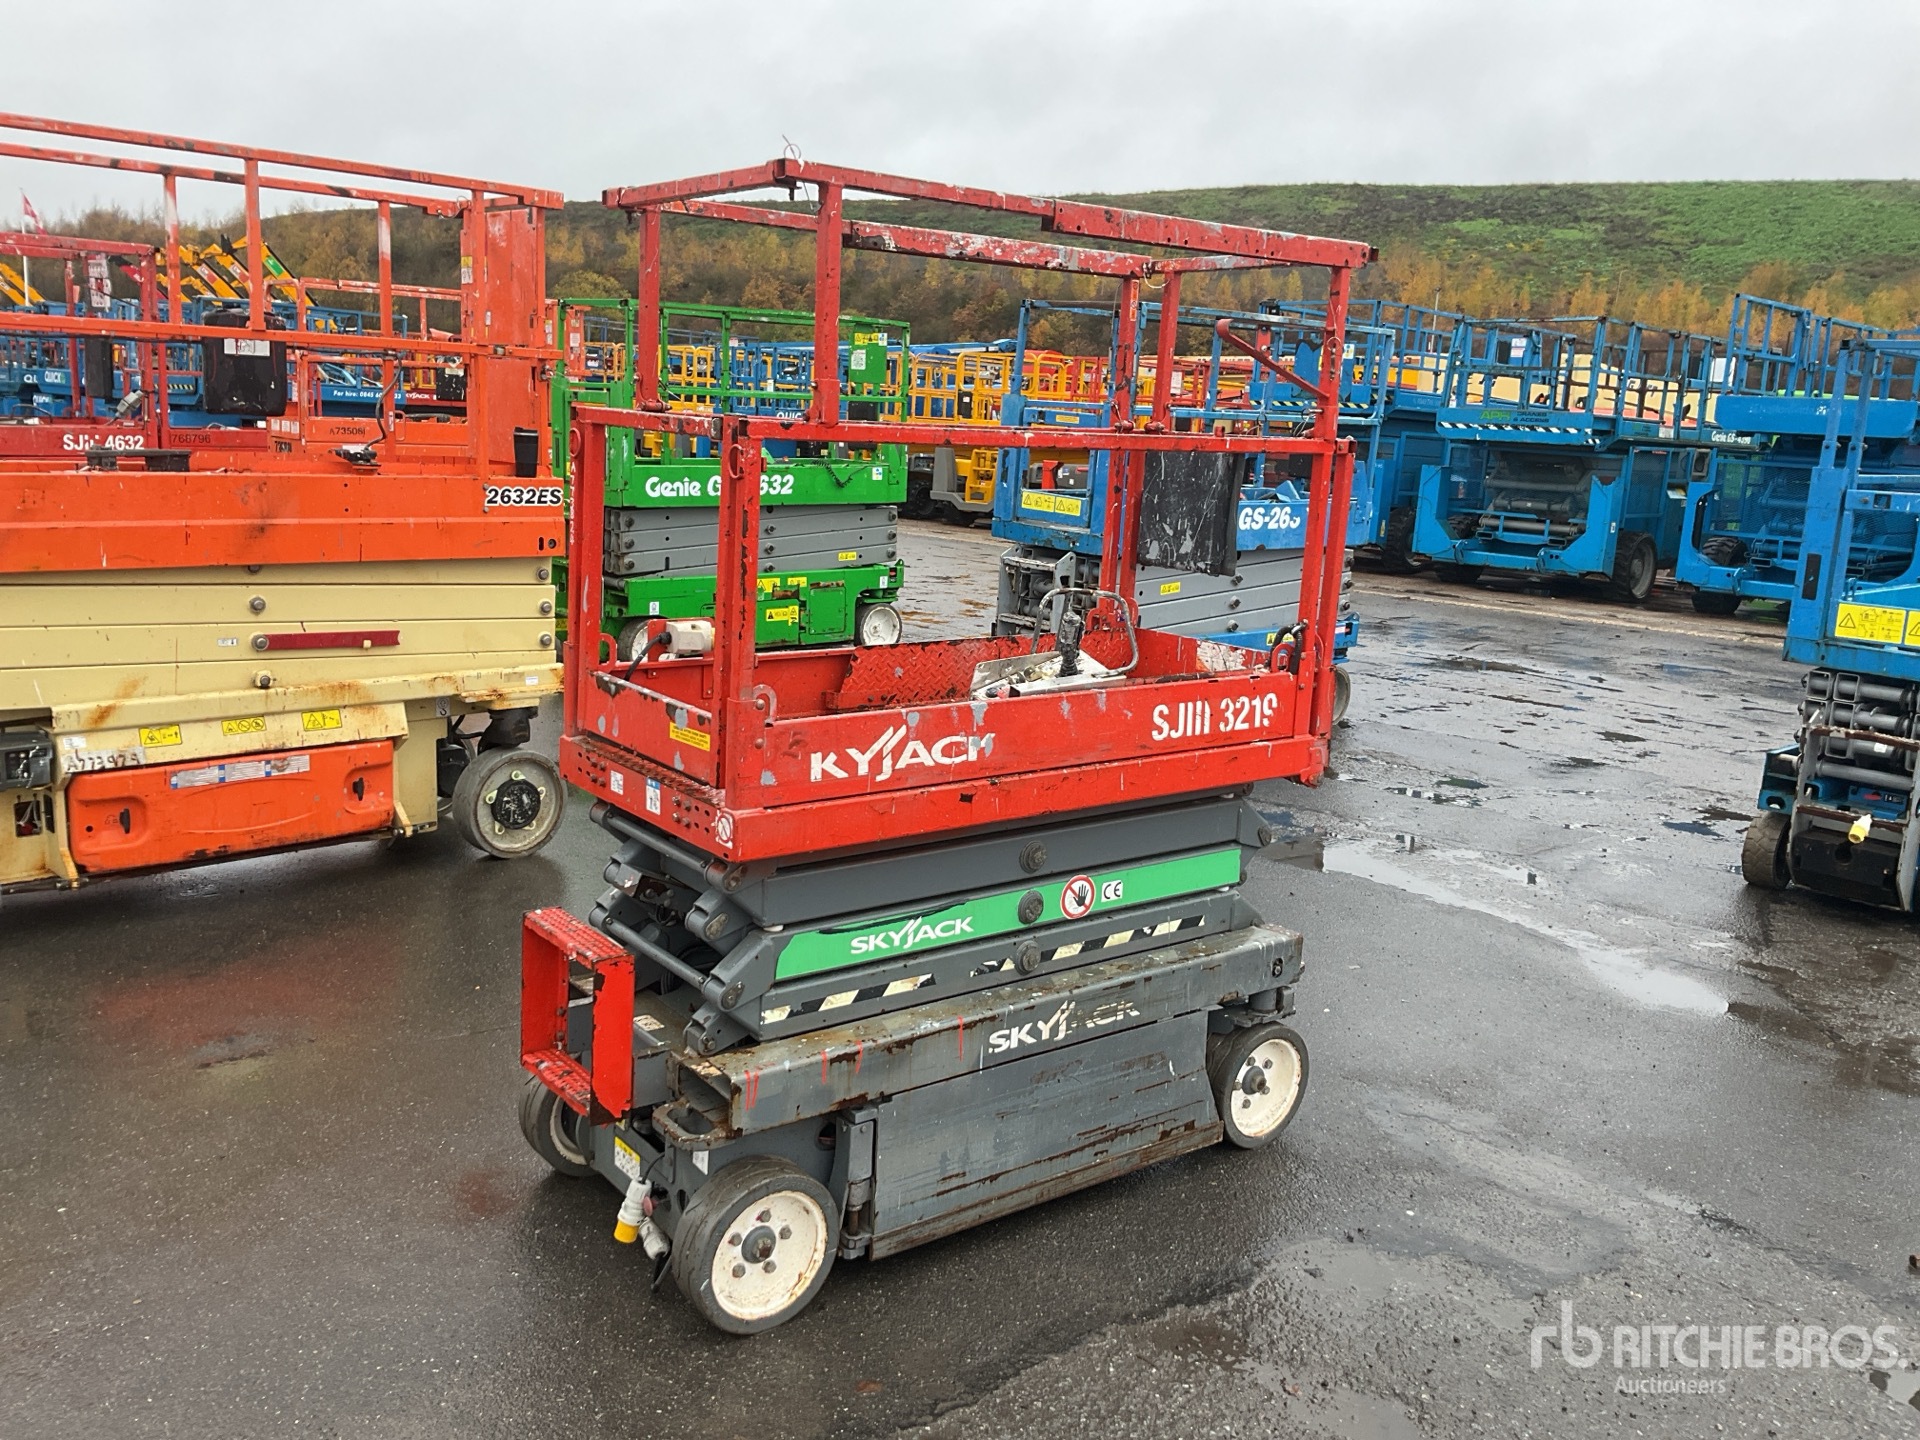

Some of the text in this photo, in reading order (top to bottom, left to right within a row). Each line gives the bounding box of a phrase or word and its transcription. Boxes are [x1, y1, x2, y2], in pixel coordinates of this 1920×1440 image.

[333, 389, 344, 397] For
[345, 389, 358, 398] hire:
[105, 434, 144, 451] 4632
[486, 487, 562, 505] 2632ES
[645, 476, 702, 498] Genie
[850, 916, 975, 955] SKYJACK
